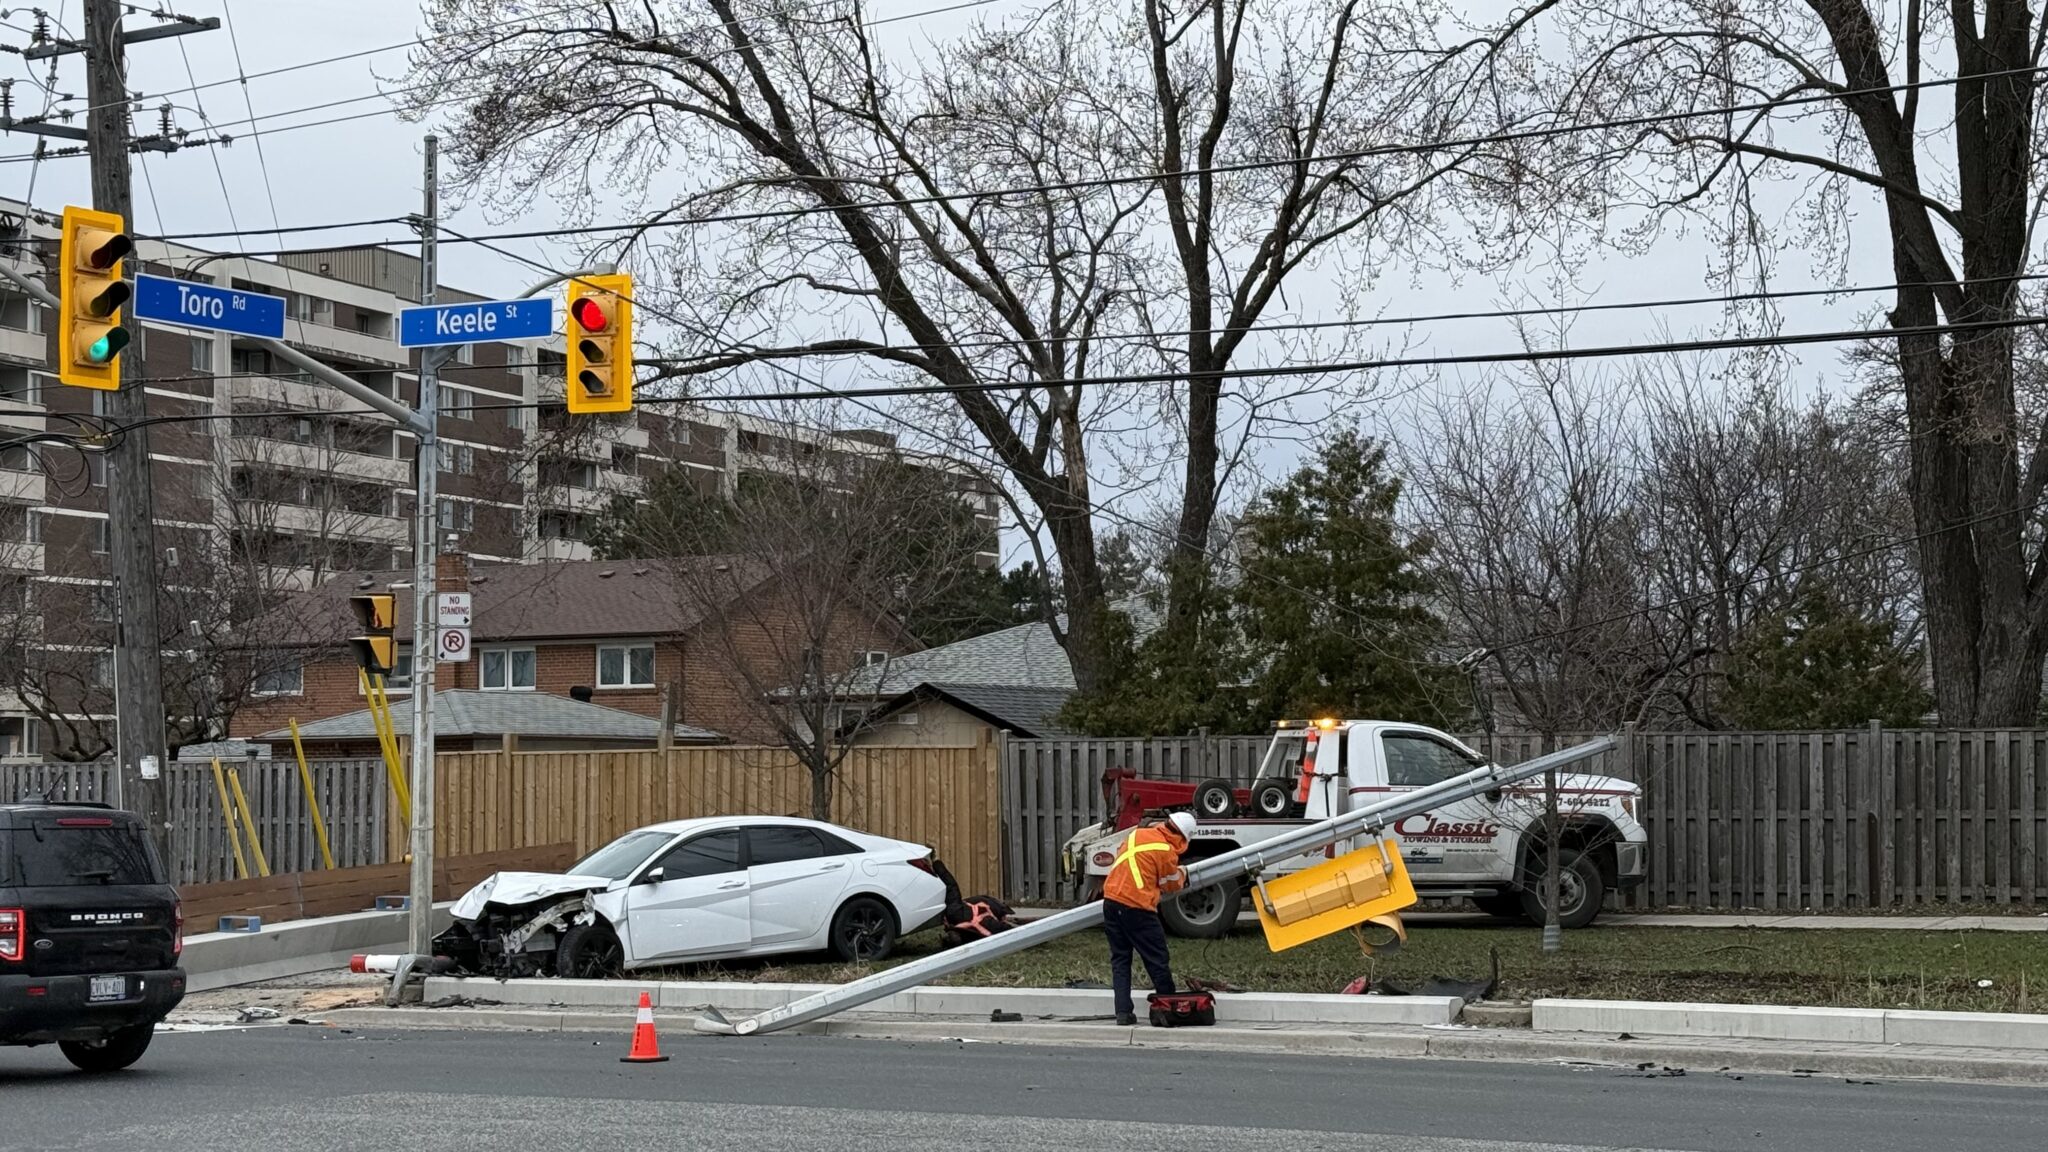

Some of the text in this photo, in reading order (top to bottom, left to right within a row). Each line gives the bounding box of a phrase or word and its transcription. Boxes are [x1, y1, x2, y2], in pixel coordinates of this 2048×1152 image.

[178, 286, 246, 319] Toro Rd
[436, 305, 517, 335] Keele St
[449, 596, 460, 604] NO
[440, 606, 469, 615] STANDING
[1393, 813, 1501, 837] Classic
[1403, 836, 1492, 844] TOWING & STORAGE
[71, 912, 143, 920] BRONCO
